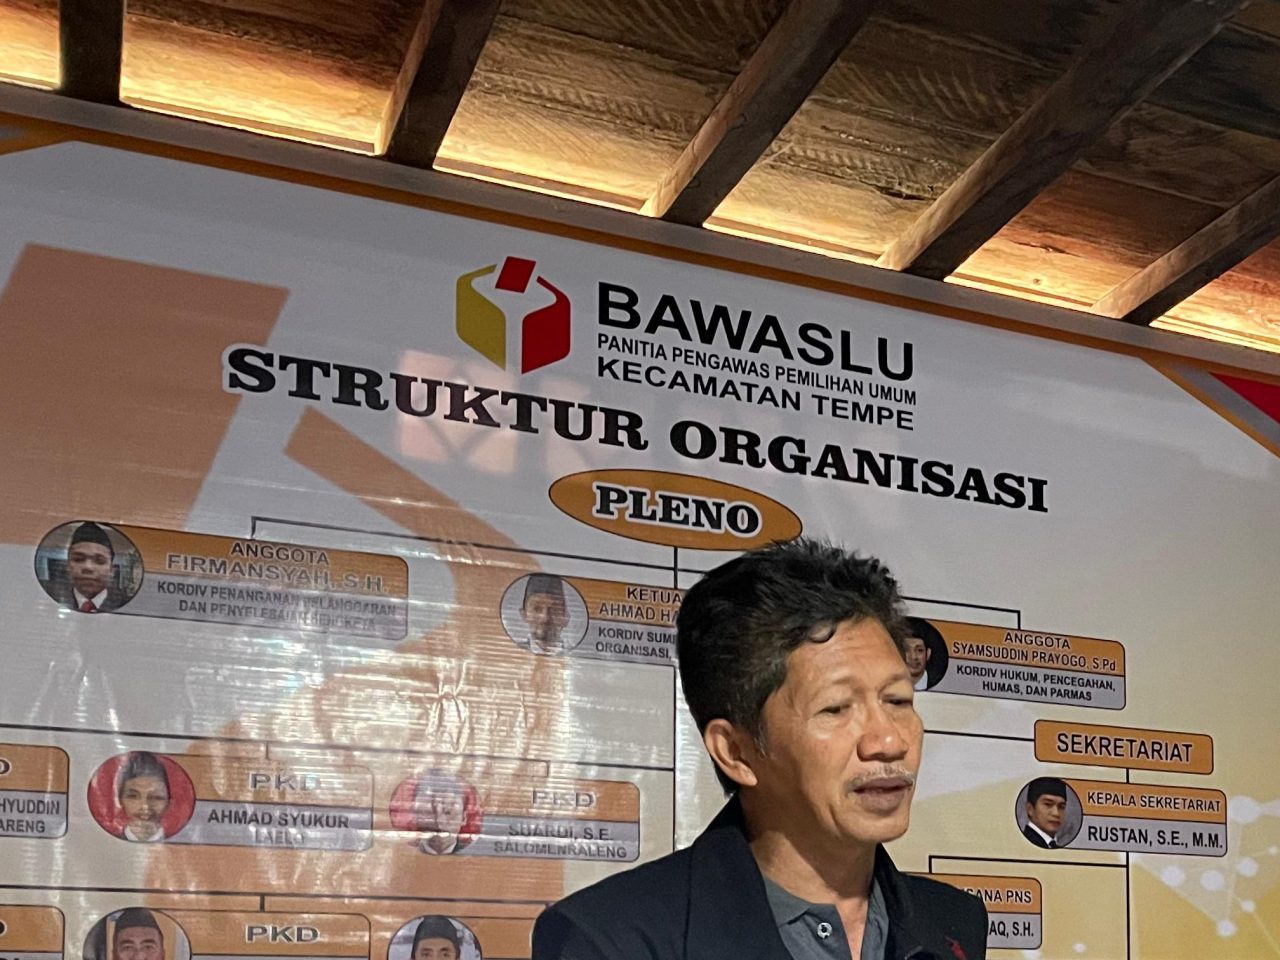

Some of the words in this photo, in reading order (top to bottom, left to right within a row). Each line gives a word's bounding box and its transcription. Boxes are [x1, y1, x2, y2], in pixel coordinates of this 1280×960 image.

[598, 281, 916, 383] BAWASLU
[598, 333, 668, 363] PANITIA
[671, 345, 771, 381] PENGAWAS
[775, 363, 864, 394] PEMILIHAN
[868, 380, 917, 406] UMUM
[598, 356, 801, 411] KECAMATAN
[812, 394, 914, 431] TEMPE
[226, 348, 648, 451] STRUKTUR
[670, 418, 1049, 513] ORGANISASI
[595, 484, 760, 535] PLENO
[231, 542, 329, 565] ANGGOTA
[158, 581, 206, 598] KORDIV
[627, 587, 682, 605] KETUA
[179, 600, 206, 613] DAN
[600, 602, 655, 621] AHMAD
[598, 627, 643, 641] KORDIV
[1005, 632, 1071, 649] ANGGOTA
[596, 642, 672, 660] ORGANISASI,
[953, 641, 1028, 662] SYAMSUDDIN
[956, 665, 997, 678] KORDIV
[1000, 669, 1040, 683] HUKUM,
[1043, 673, 1116, 692] PENCEGAHAN,
[982, 681, 1023, 695] HUMAS,
[1026, 685, 1047, 696] DAN
[1050, 688, 1092, 701] PARMAS
[1056, 733, 1192, 763] SEKRETARIAT
[1087, 791, 1137, 807] KEPALA
[1140, 795, 1221, 813] SEKRETARIAT
[208, 809, 272, 825] AHMAD
[277, 811, 349, 829] SYUKUR
[1088, 826, 1153, 845] RUSTAN,
[1157, 829, 1189, 848] S.E.,
[1192, 831, 1223, 848] M.M.
[1006, 890, 1032, 903] PNS
[246, 924, 319, 944] PKD
[1012, 921, 1034, 936] S.H.
